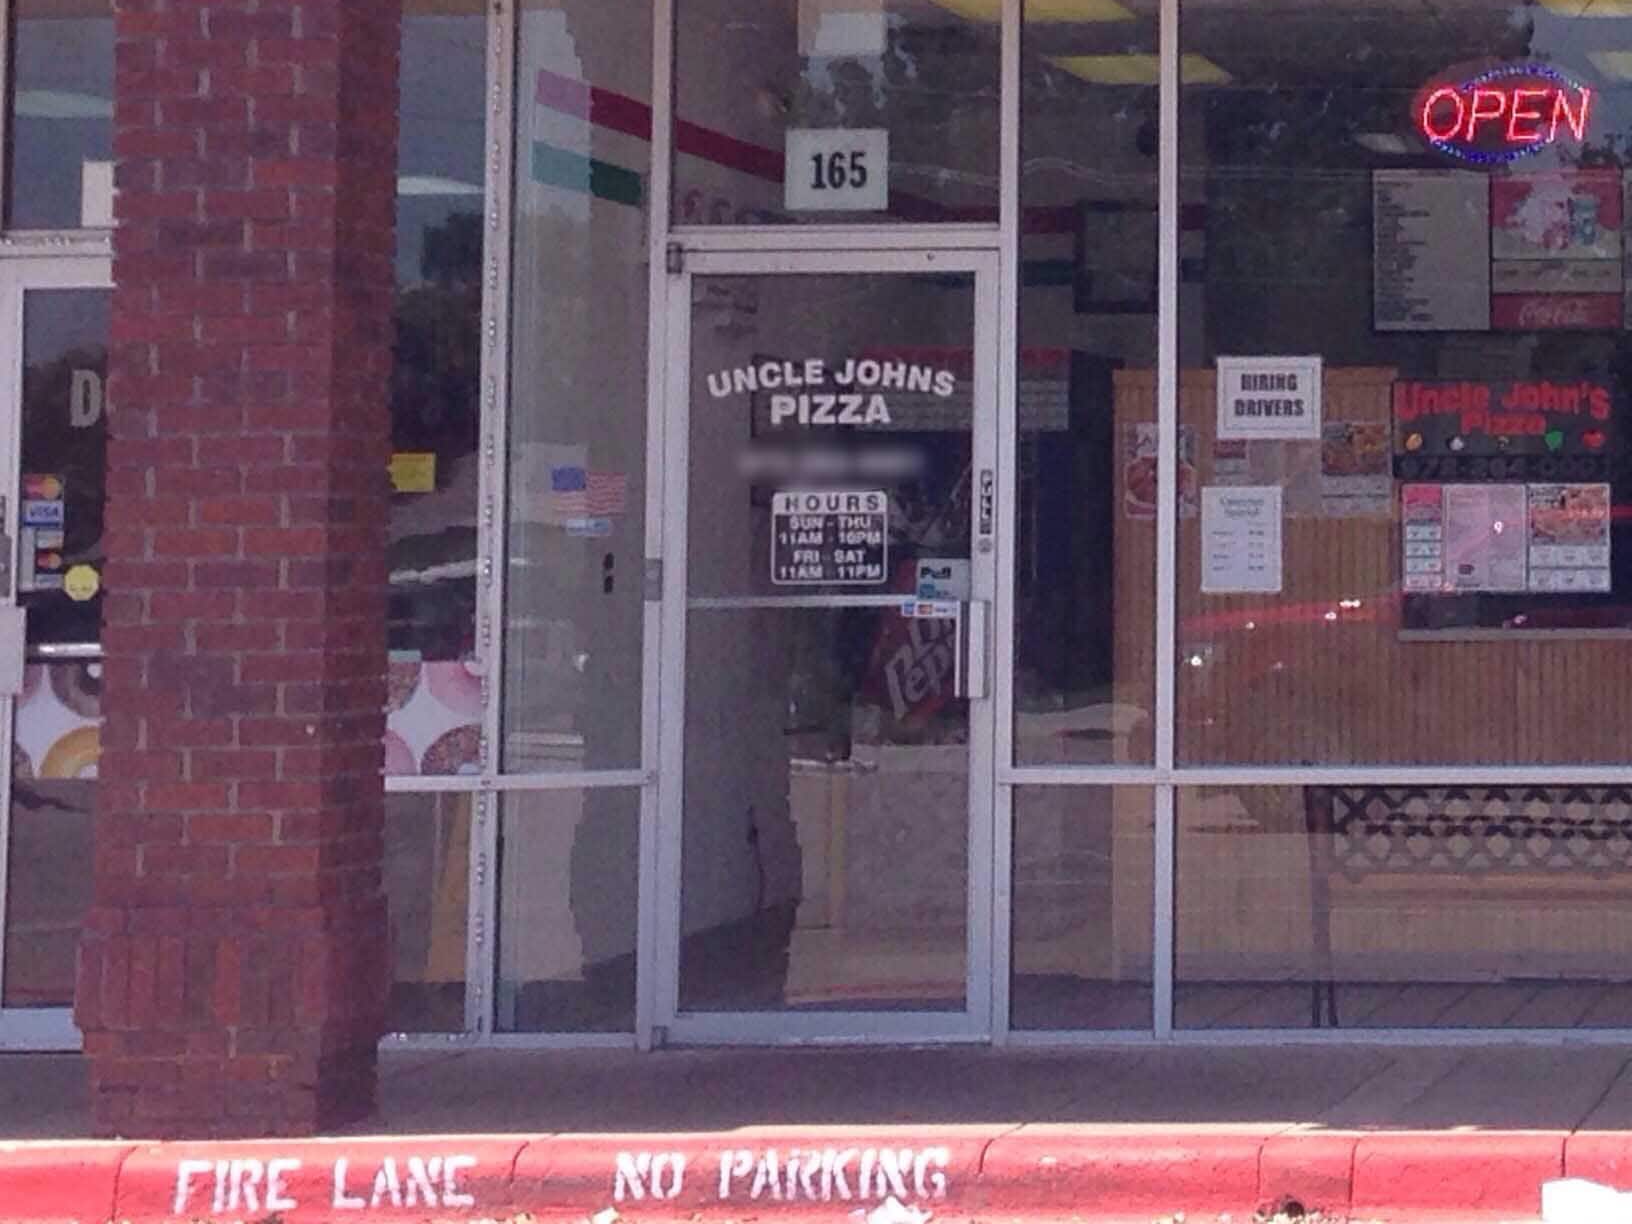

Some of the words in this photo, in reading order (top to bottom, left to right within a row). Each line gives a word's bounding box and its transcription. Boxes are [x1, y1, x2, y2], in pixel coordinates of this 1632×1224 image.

[1422, 86, 1592, 143] OPEN
[810, 152, 868, 189] 165
[707, 359, 824, 397] UNCLE
[835, 359, 956, 397] JOHNS
[1240, 373, 1298, 391] HIRING
[770, 394, 891, 424] PIZZA
[1234, 399, 1304, 417] DRIVERS
[785, 495, 879, 511] HOURS
[173, 1158, 300, 1214] FIRE
[331, 1154, 477, 1208] LANE
[614, 1151, 686, 1201] NO
[719, 1147, 949, 1201] PARKING
